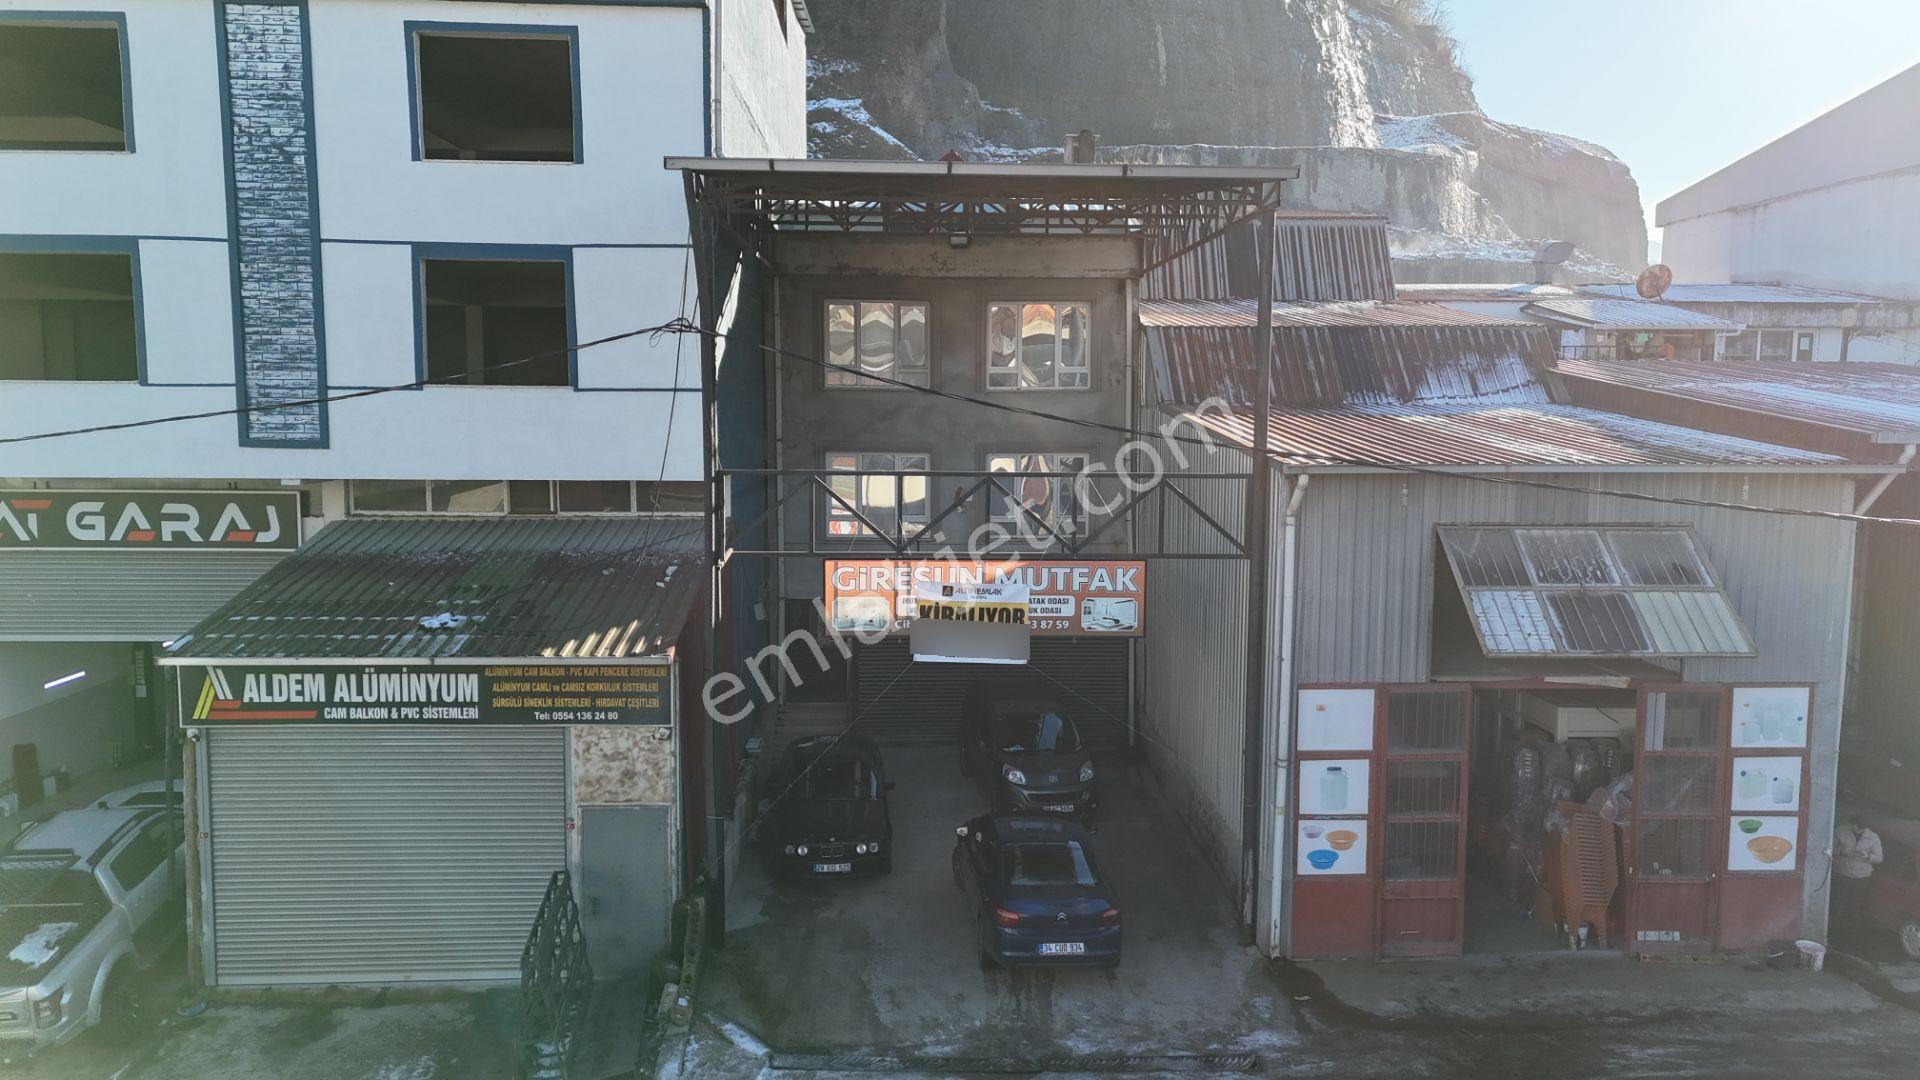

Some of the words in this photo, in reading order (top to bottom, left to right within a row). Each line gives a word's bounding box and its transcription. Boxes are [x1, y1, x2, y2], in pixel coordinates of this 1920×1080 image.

[66, 501, 280, 542] GARAJ
[994, 565, 1141, 592] MUTFAK
[1047, 597, 1070, 605] ODASI
[1040, 606, 1062, 614] ODASI
[1040, 620, 1053, 630] 87
[1055, 620, 1069, 630] 59
[484, 665, 523, 677] ALÜMİNYUM
[523, 666, 538, 677] CAM
[540, 666, 565, 677] BALKON
[569, 666, 583, 677] PVC
[584, 666, 599, 677] KAPI
[600, 666, 629, 678] PENCERE
[242, 673, 326, 703] ALDEM
[333, 667, 479, 703] ALÜMİNYUM
[492, 681, 531, 692] ALÜMİNYUM
[531, 682, 551, 692] CAMLI
[552, 684, 561, 692] ve
[561, 682, 585, 692] CAMSIZ
[586, 682, 621, 692] KORKULUK
[492, 696, 522, 708] SÜRGÜLÜ
[554, 696, 591, 708] SİSTEMLERİ
[595, 696, 626, 708] HIRDAVAT
[324, 707, 346, 720] CAM
[349, 707, 388, 720] BALKON
[390, 707, 399, 720] &
[400, 707, 420, 720] PVC
[422, 705, 479, 720] SİSTEMLERİ
[533, 711, 551, 721] Tel:
[552, 711, 574, 721] 0554
[576, 711, 592, 721] 136
[594, 711, 606, 721] 24
[607, 711, 619, 721] 80
